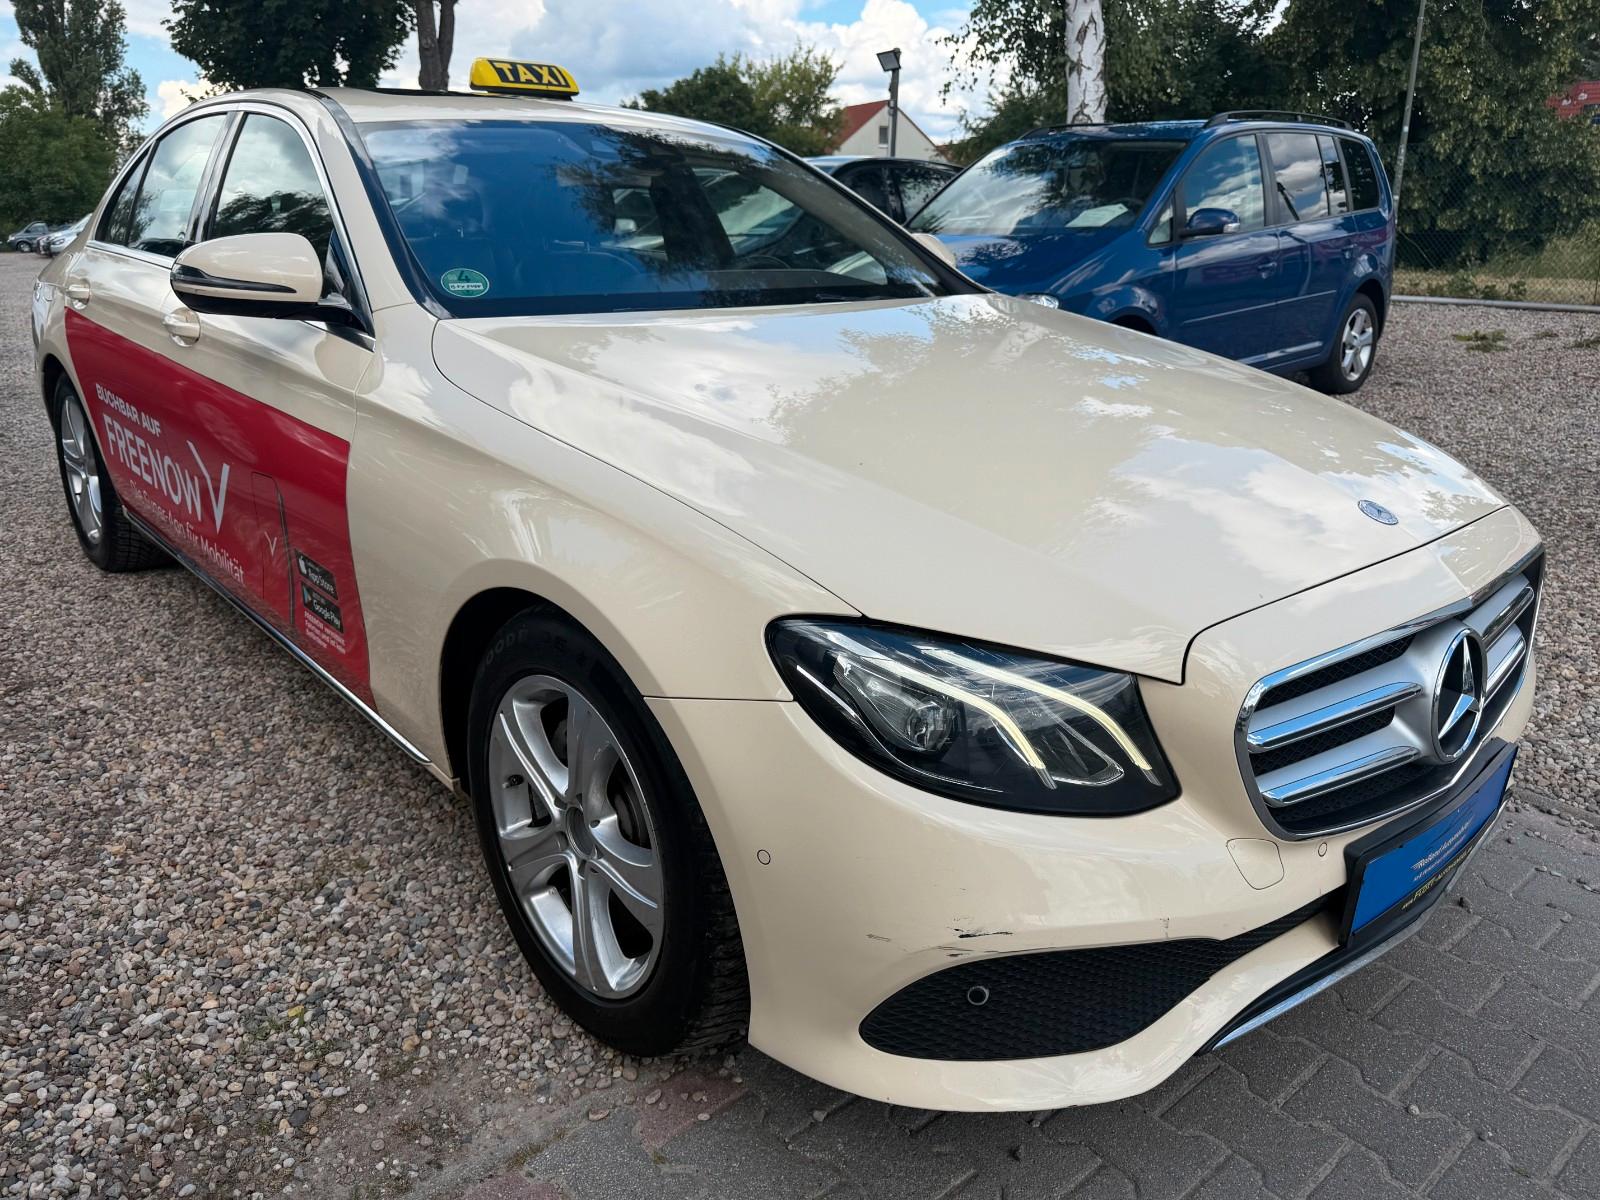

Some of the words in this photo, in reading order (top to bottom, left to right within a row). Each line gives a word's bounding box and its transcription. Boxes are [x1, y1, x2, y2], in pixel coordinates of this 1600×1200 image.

[492, 62, 567, 87] TAXI
[95, 383, 140, 425] BUCHBAR
[141, 412, 161, 438] AUF
[103, 414, 202, 522] FREENOW
[200, 535, 244, 585] Mobilität
